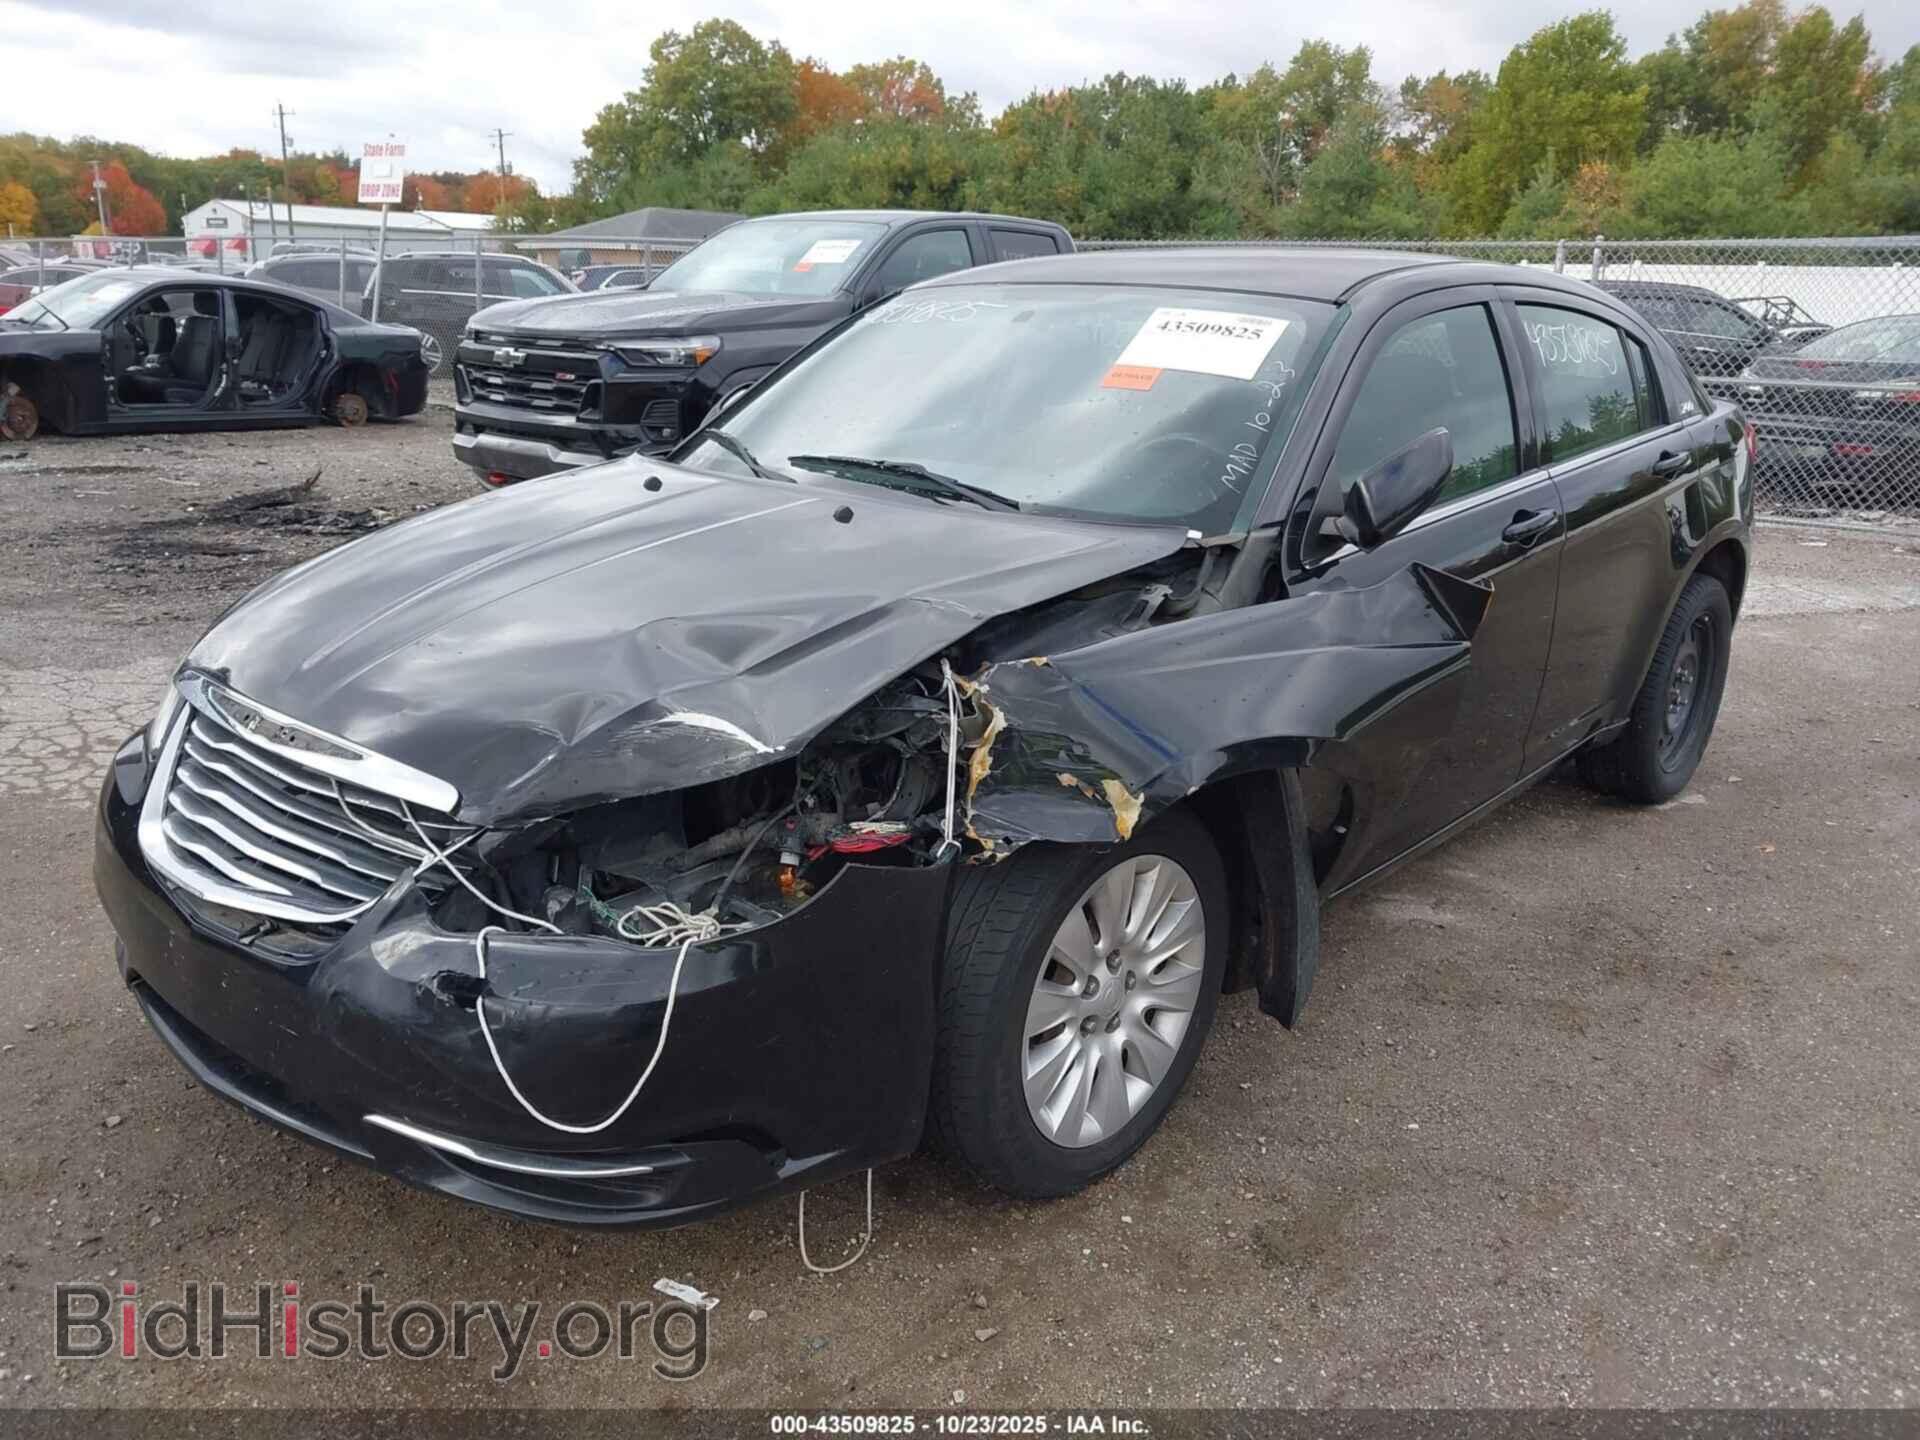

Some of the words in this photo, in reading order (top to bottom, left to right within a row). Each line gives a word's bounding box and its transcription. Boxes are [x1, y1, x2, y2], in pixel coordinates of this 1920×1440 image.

[363, 143, 383, 157] State
[385, 143, 405, 157] Farm
[360, 183, 380, 198] DROP
[382, 183, 401, 198] ZONE
[1155, 319, 1264, 341] 43509825
